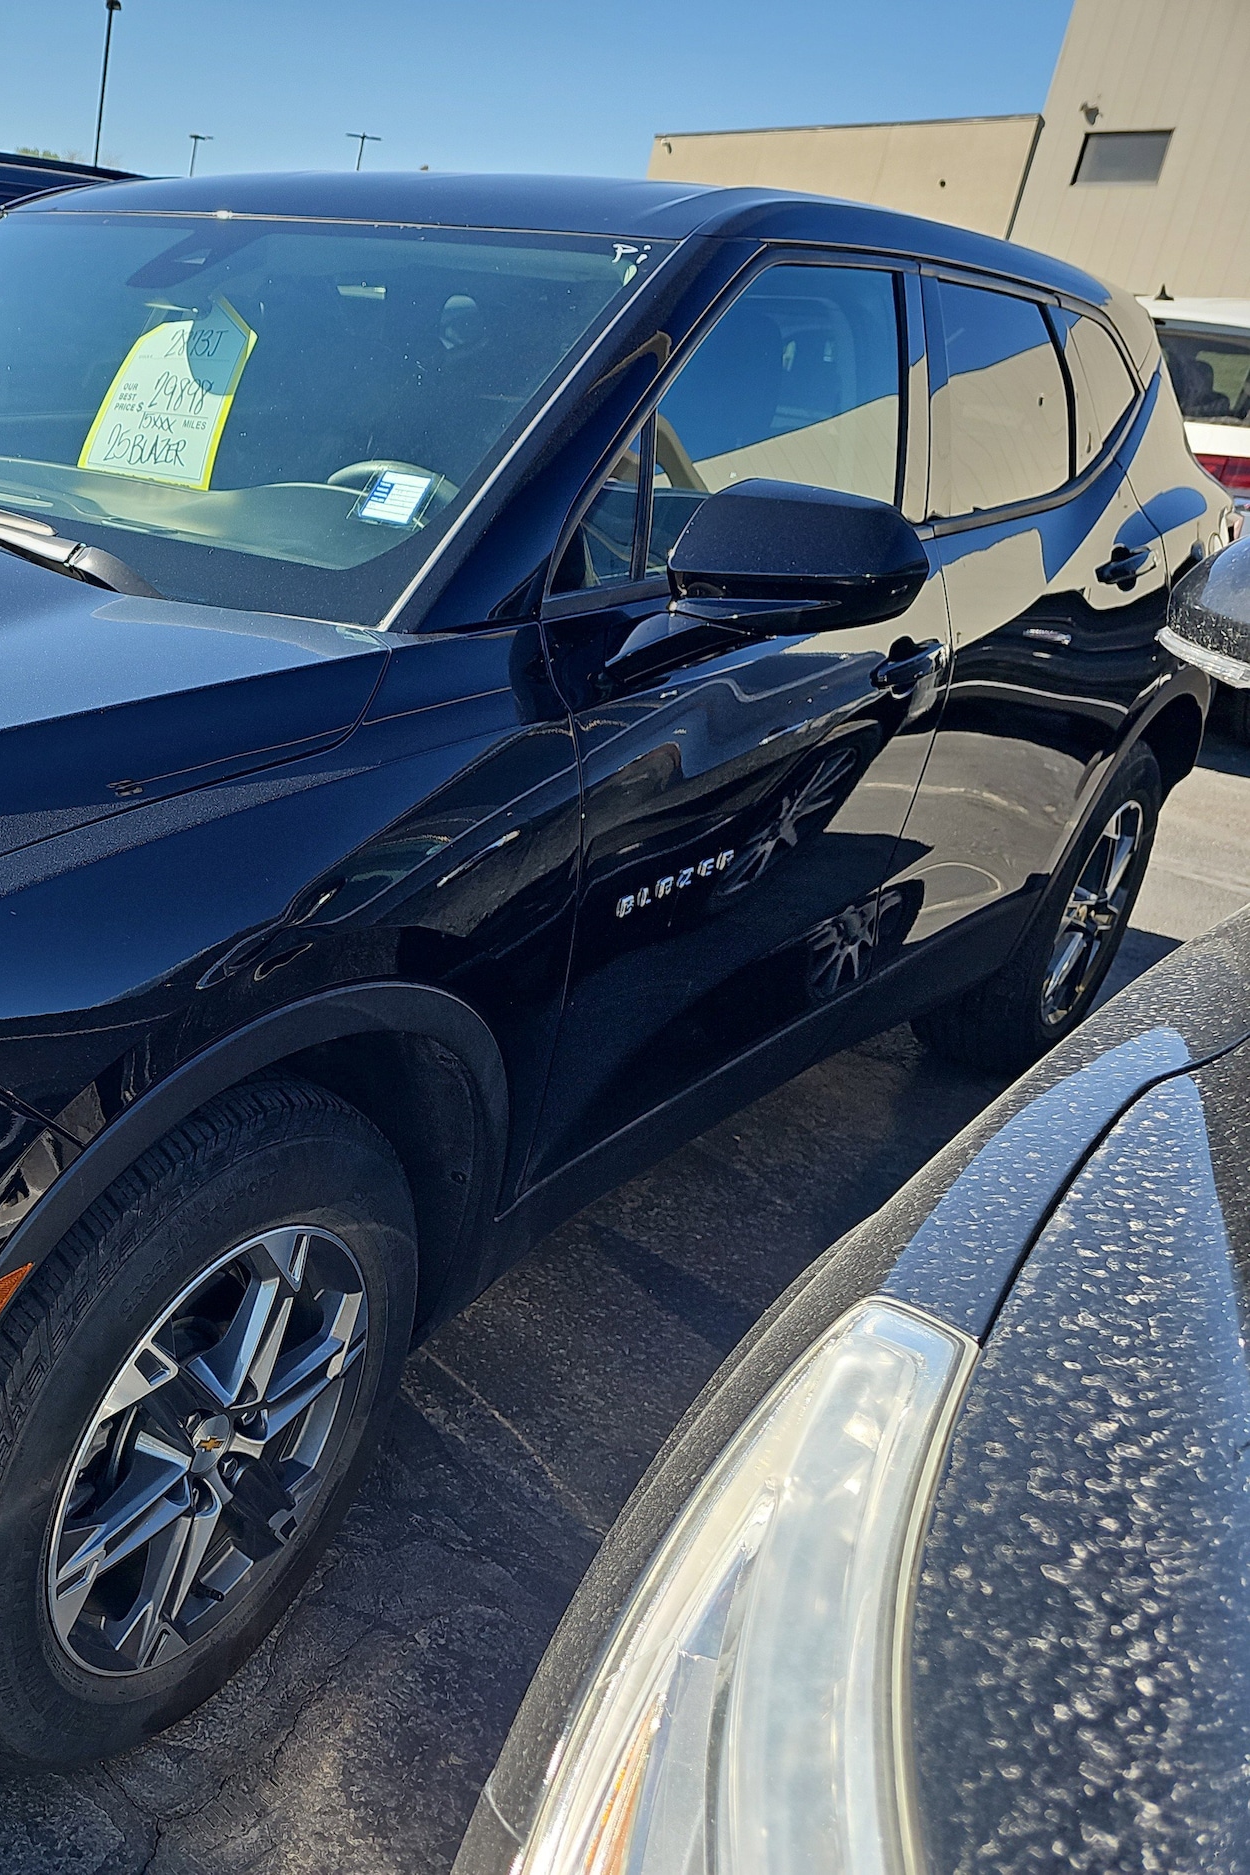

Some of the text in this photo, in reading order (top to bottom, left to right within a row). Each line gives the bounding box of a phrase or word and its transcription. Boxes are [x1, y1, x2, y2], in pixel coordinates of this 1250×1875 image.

[123, 382, 139, 391] OUR
[114, 402, 136, 412] PRICE
[147, 371, 214, 415] 29898
[118, 393, 137, 401] BEST
[182, 419, 207, 431] MILES
